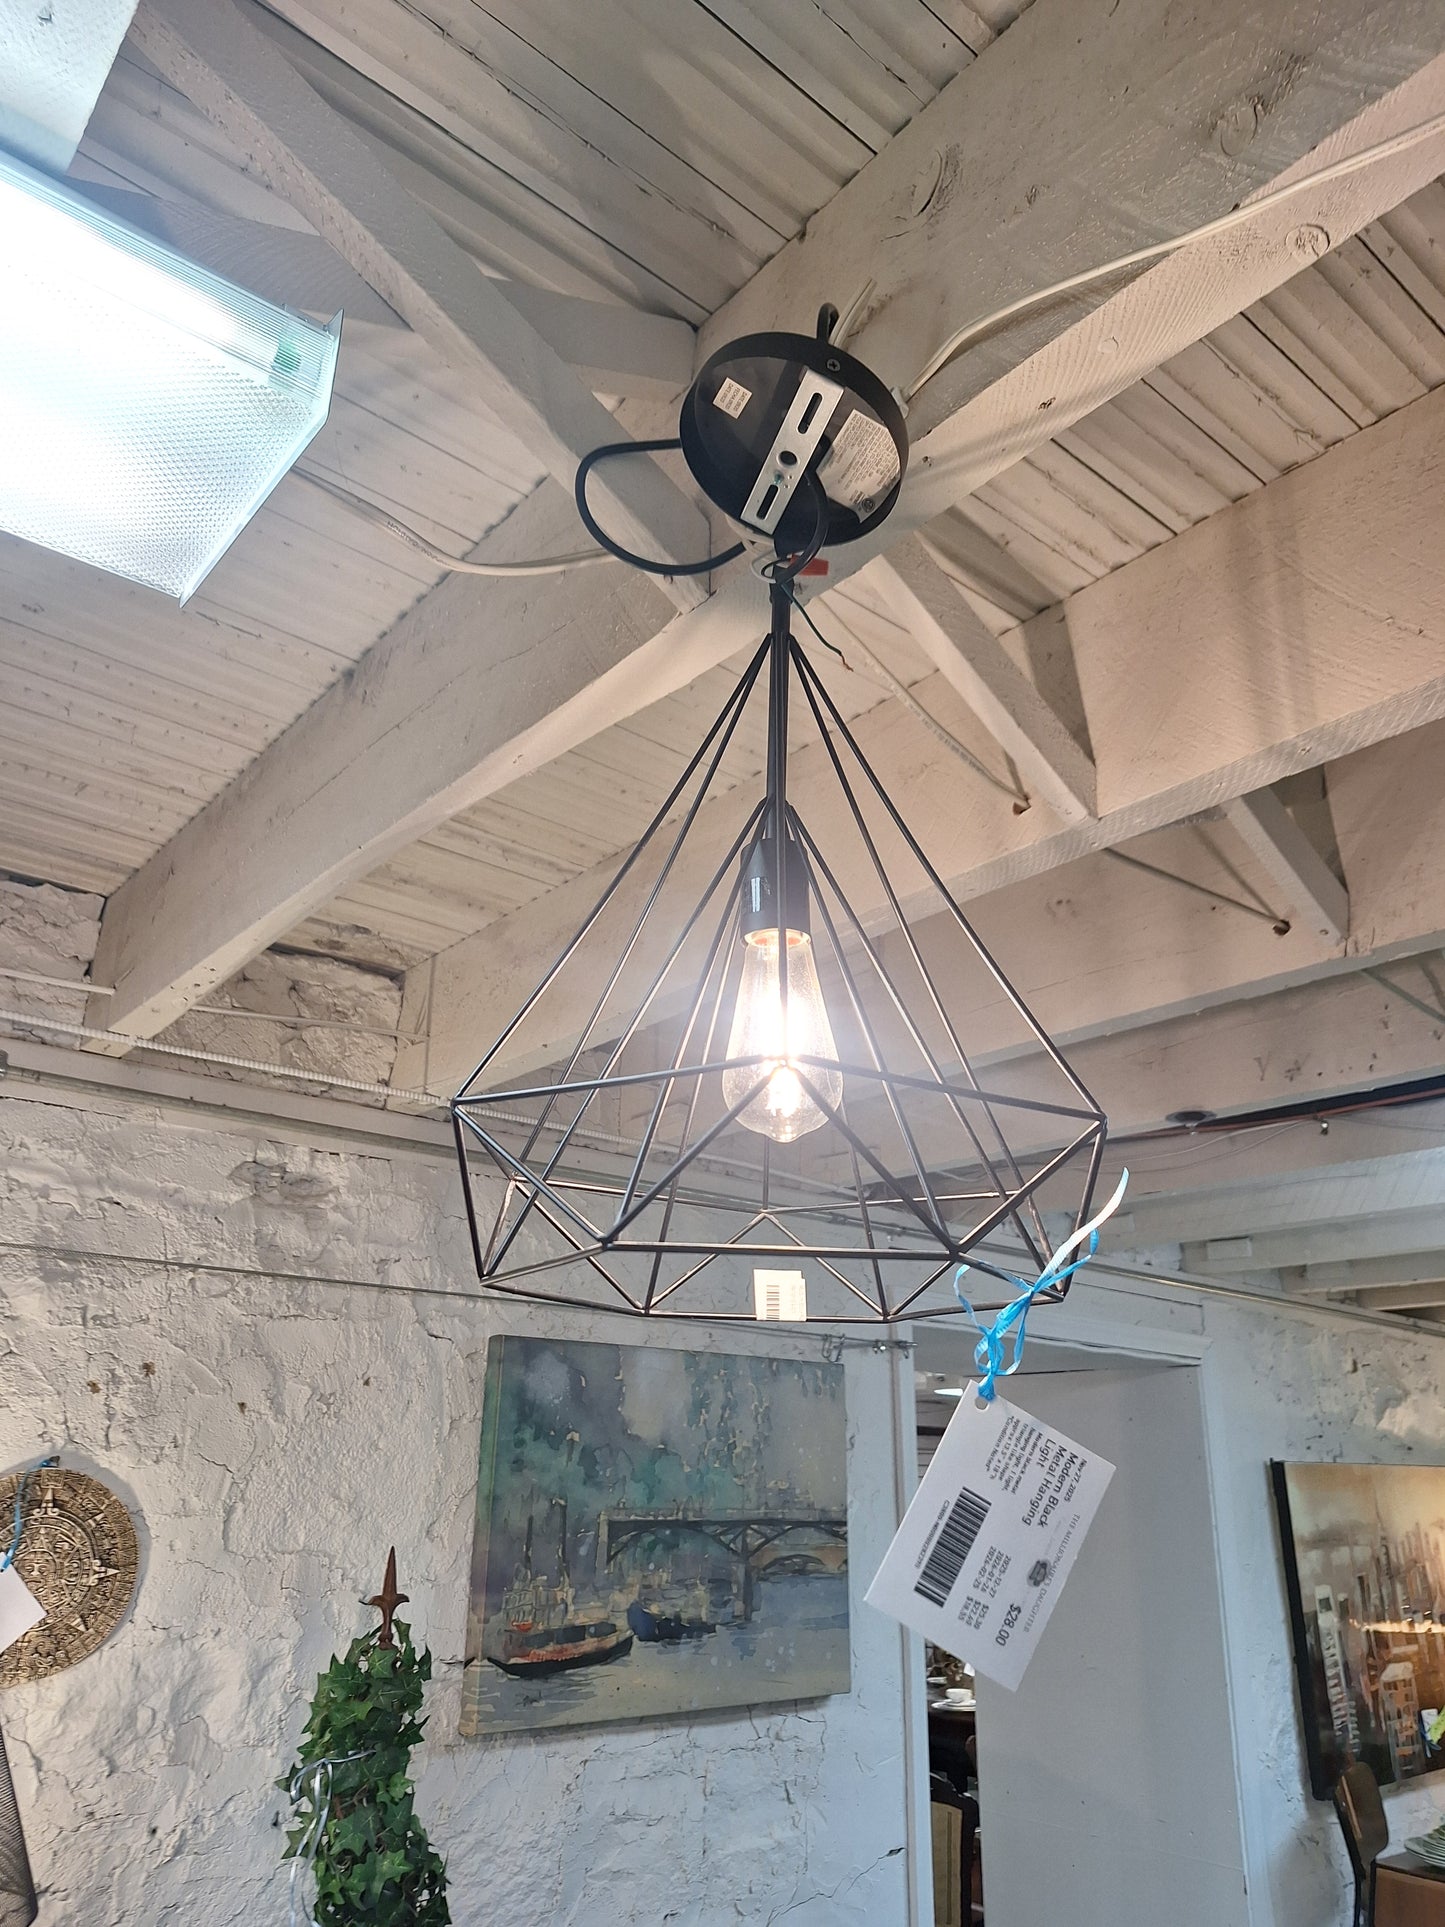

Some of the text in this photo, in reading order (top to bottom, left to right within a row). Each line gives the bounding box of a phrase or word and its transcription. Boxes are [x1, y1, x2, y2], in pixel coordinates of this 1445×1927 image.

[997, 1422, 1028, 1481] triangle like shape
[1019, 1426, 1035, 1452] hanging
[1028, 1431, 1042, 1457] Modern
[1033, 1436, 1056, 1468] Light
[1020, 1444, 1067, 1527] Metal Hanging
[1052, 1451, 1078, 1494] Modern
[1036, 1494, 1059, 1529] Black
[994, 1602, 1022, 1647] $28.00
